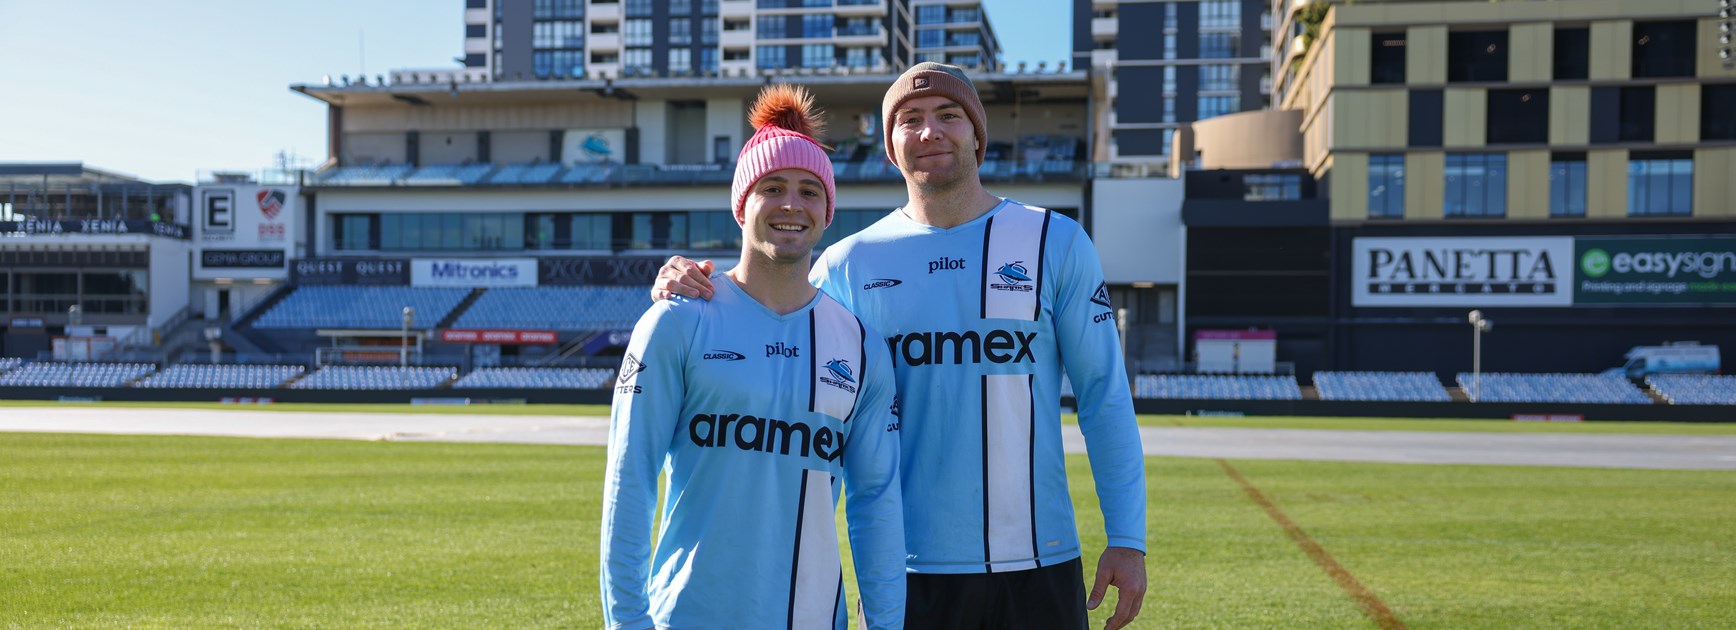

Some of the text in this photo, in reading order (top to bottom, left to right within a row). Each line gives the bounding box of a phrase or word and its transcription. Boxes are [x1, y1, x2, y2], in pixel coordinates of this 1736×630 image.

[208, 196, 229, 226] E
[17, 219, 63, 233] XENIA
[81, 219, 128, 233] XENIA
[152, 222, 184, 238] XENIA
[297, 260, 342, 276] QUEST
[356, 260, 401, 276] QUEST
[431, 262, 518, 280] Mitronics
[928, 257, 966, 274] pilot
[1367, 249, 1556, 280] PANETTA
[863, 281, 891, 290] CLASSIC
[1377, 283, 1546, 293] MERCATO
[703, 353, 735, 361] CLASSIC
[765, 342, 799, 358] pilot
